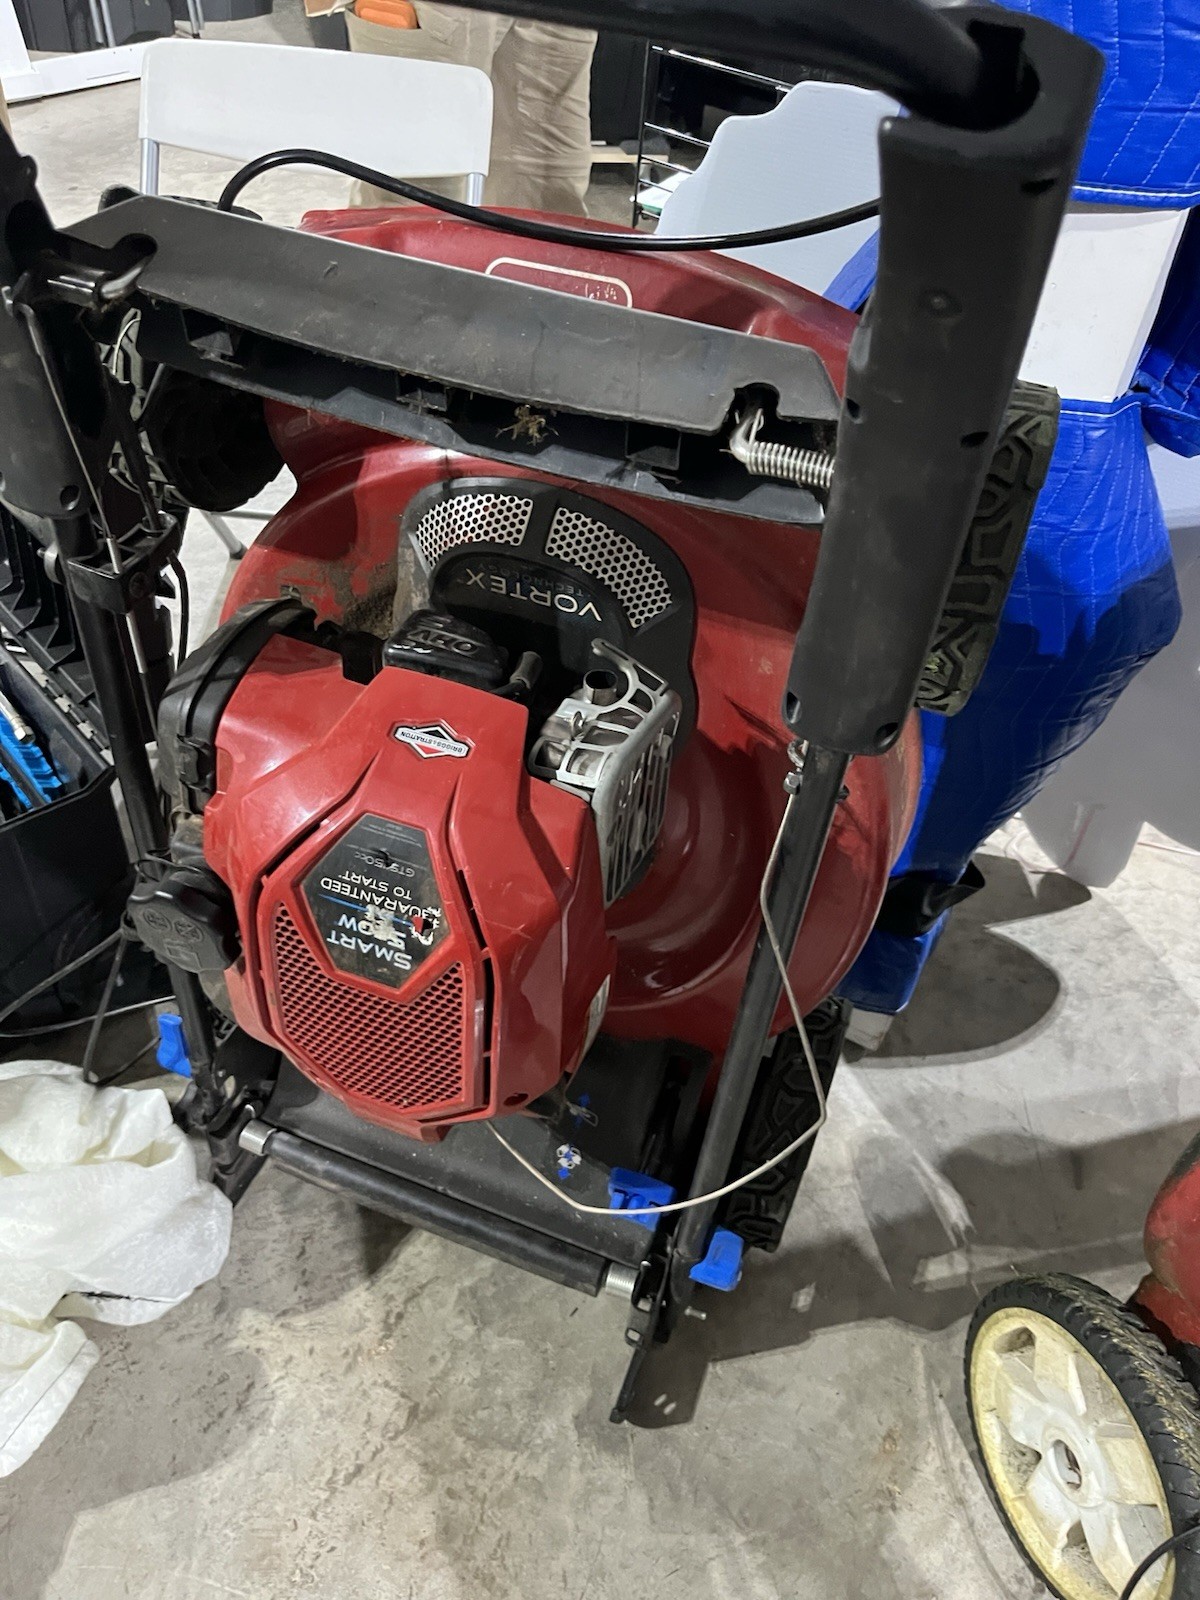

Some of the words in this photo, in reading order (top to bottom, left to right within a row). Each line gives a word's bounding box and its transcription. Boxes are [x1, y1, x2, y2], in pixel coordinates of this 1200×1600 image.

[465, 567, 602, 622] VORTEX
[479, 563, 585, 597] TECHNOLOGY
[399, 731, 432, 744] STRATTON
[436, 741, 463, 753] BRIGGS
[393, 886, 412, 900] TO
[337, 913, 407, 950] SOW
[326, 929, 413, 971] SMART
